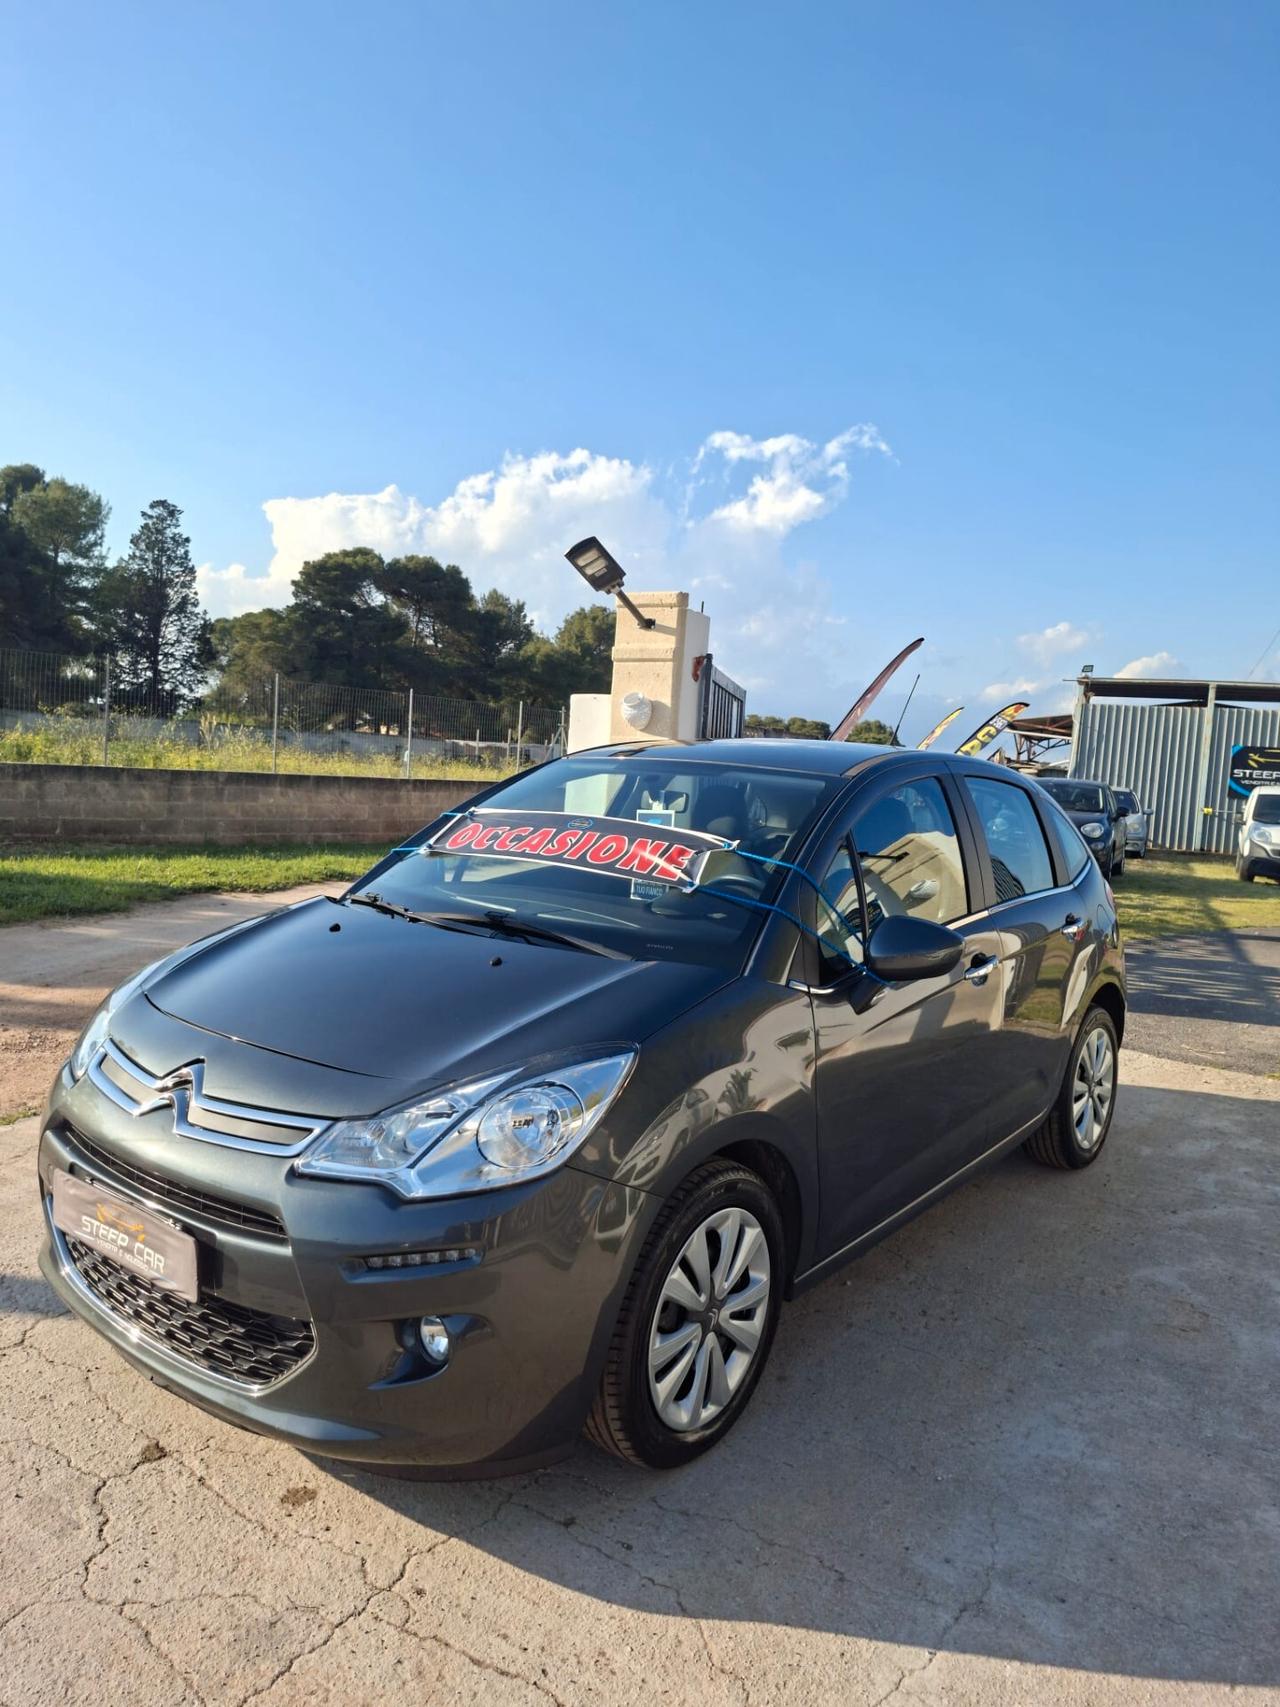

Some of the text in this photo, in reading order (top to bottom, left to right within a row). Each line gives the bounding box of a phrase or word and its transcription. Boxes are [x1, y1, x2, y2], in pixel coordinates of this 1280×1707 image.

[446, 822, 695, 881] OCCASIONE
[81, 1216, 165, 1273] STEEP CAR
